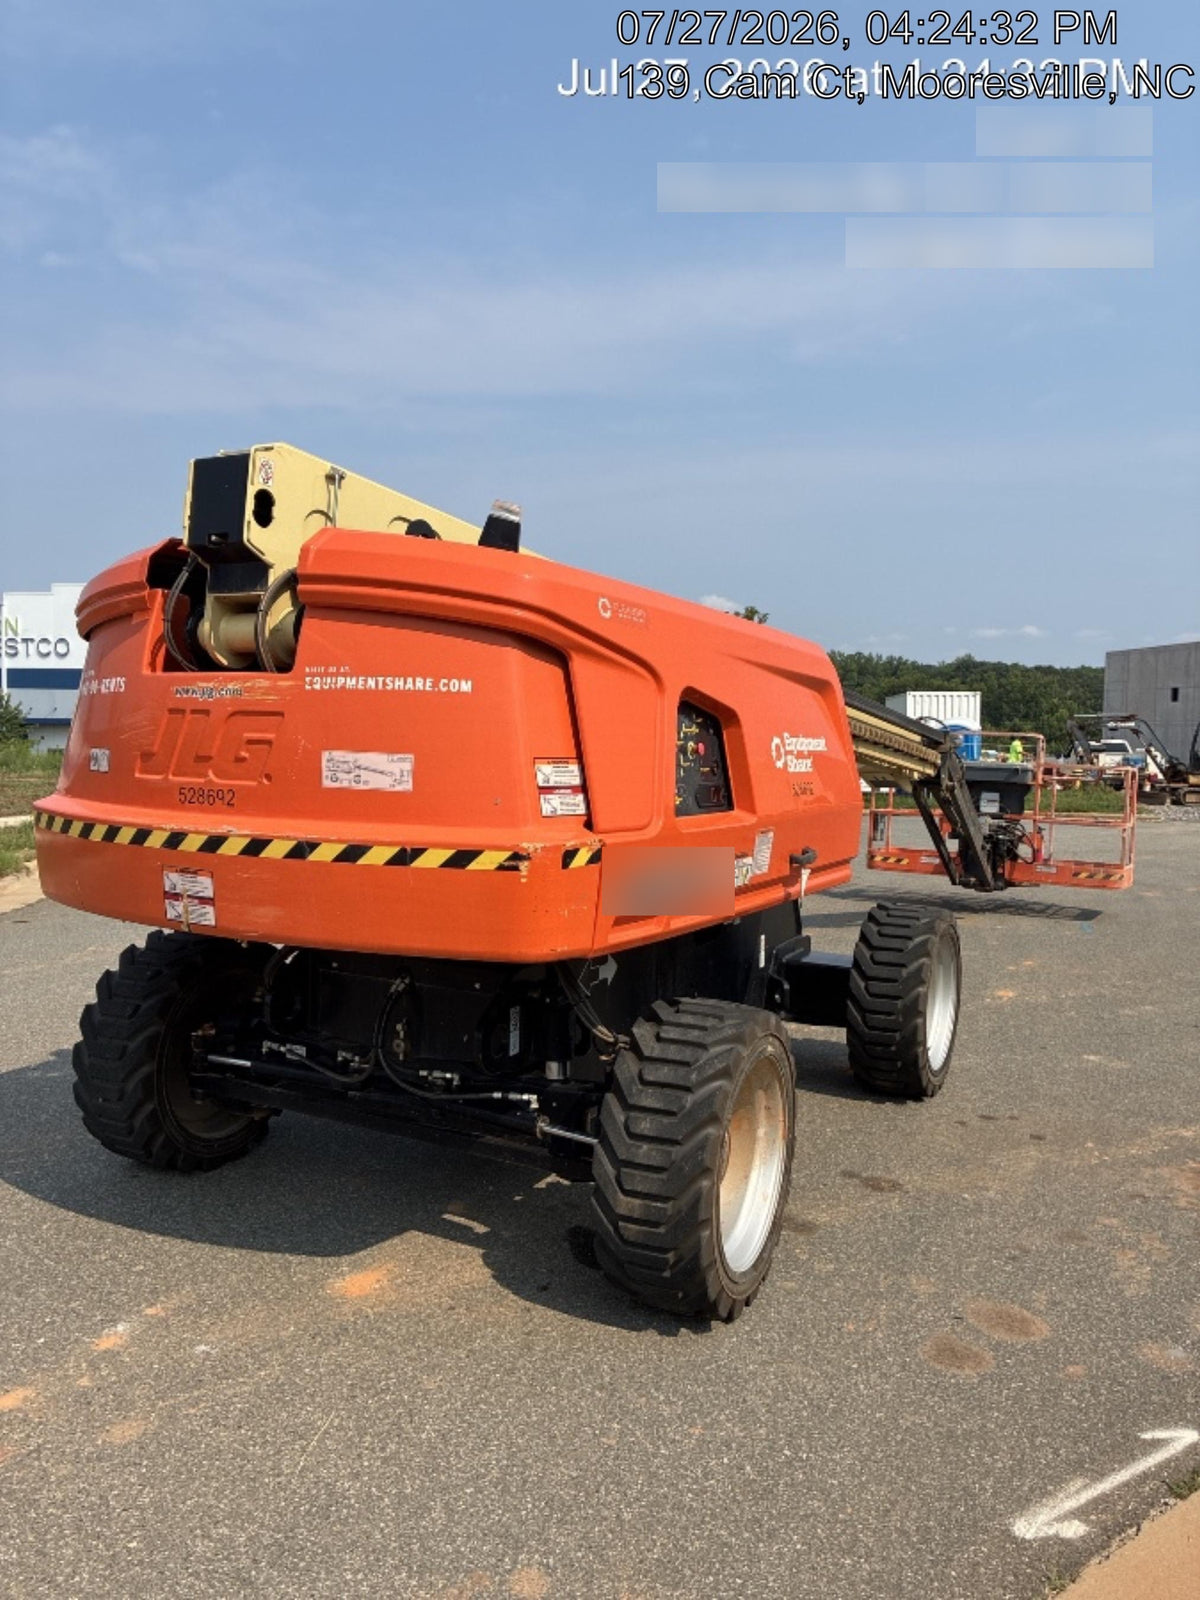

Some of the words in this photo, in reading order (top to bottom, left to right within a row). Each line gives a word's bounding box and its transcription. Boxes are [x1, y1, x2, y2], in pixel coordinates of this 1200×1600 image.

[1, 637, 70, 659] STCO
[304, 676, 473, 693] EQUIPMENTSHARE.COM
[135, 707, 286, 786] JLG
[178, 786, 236, 807] 528692
